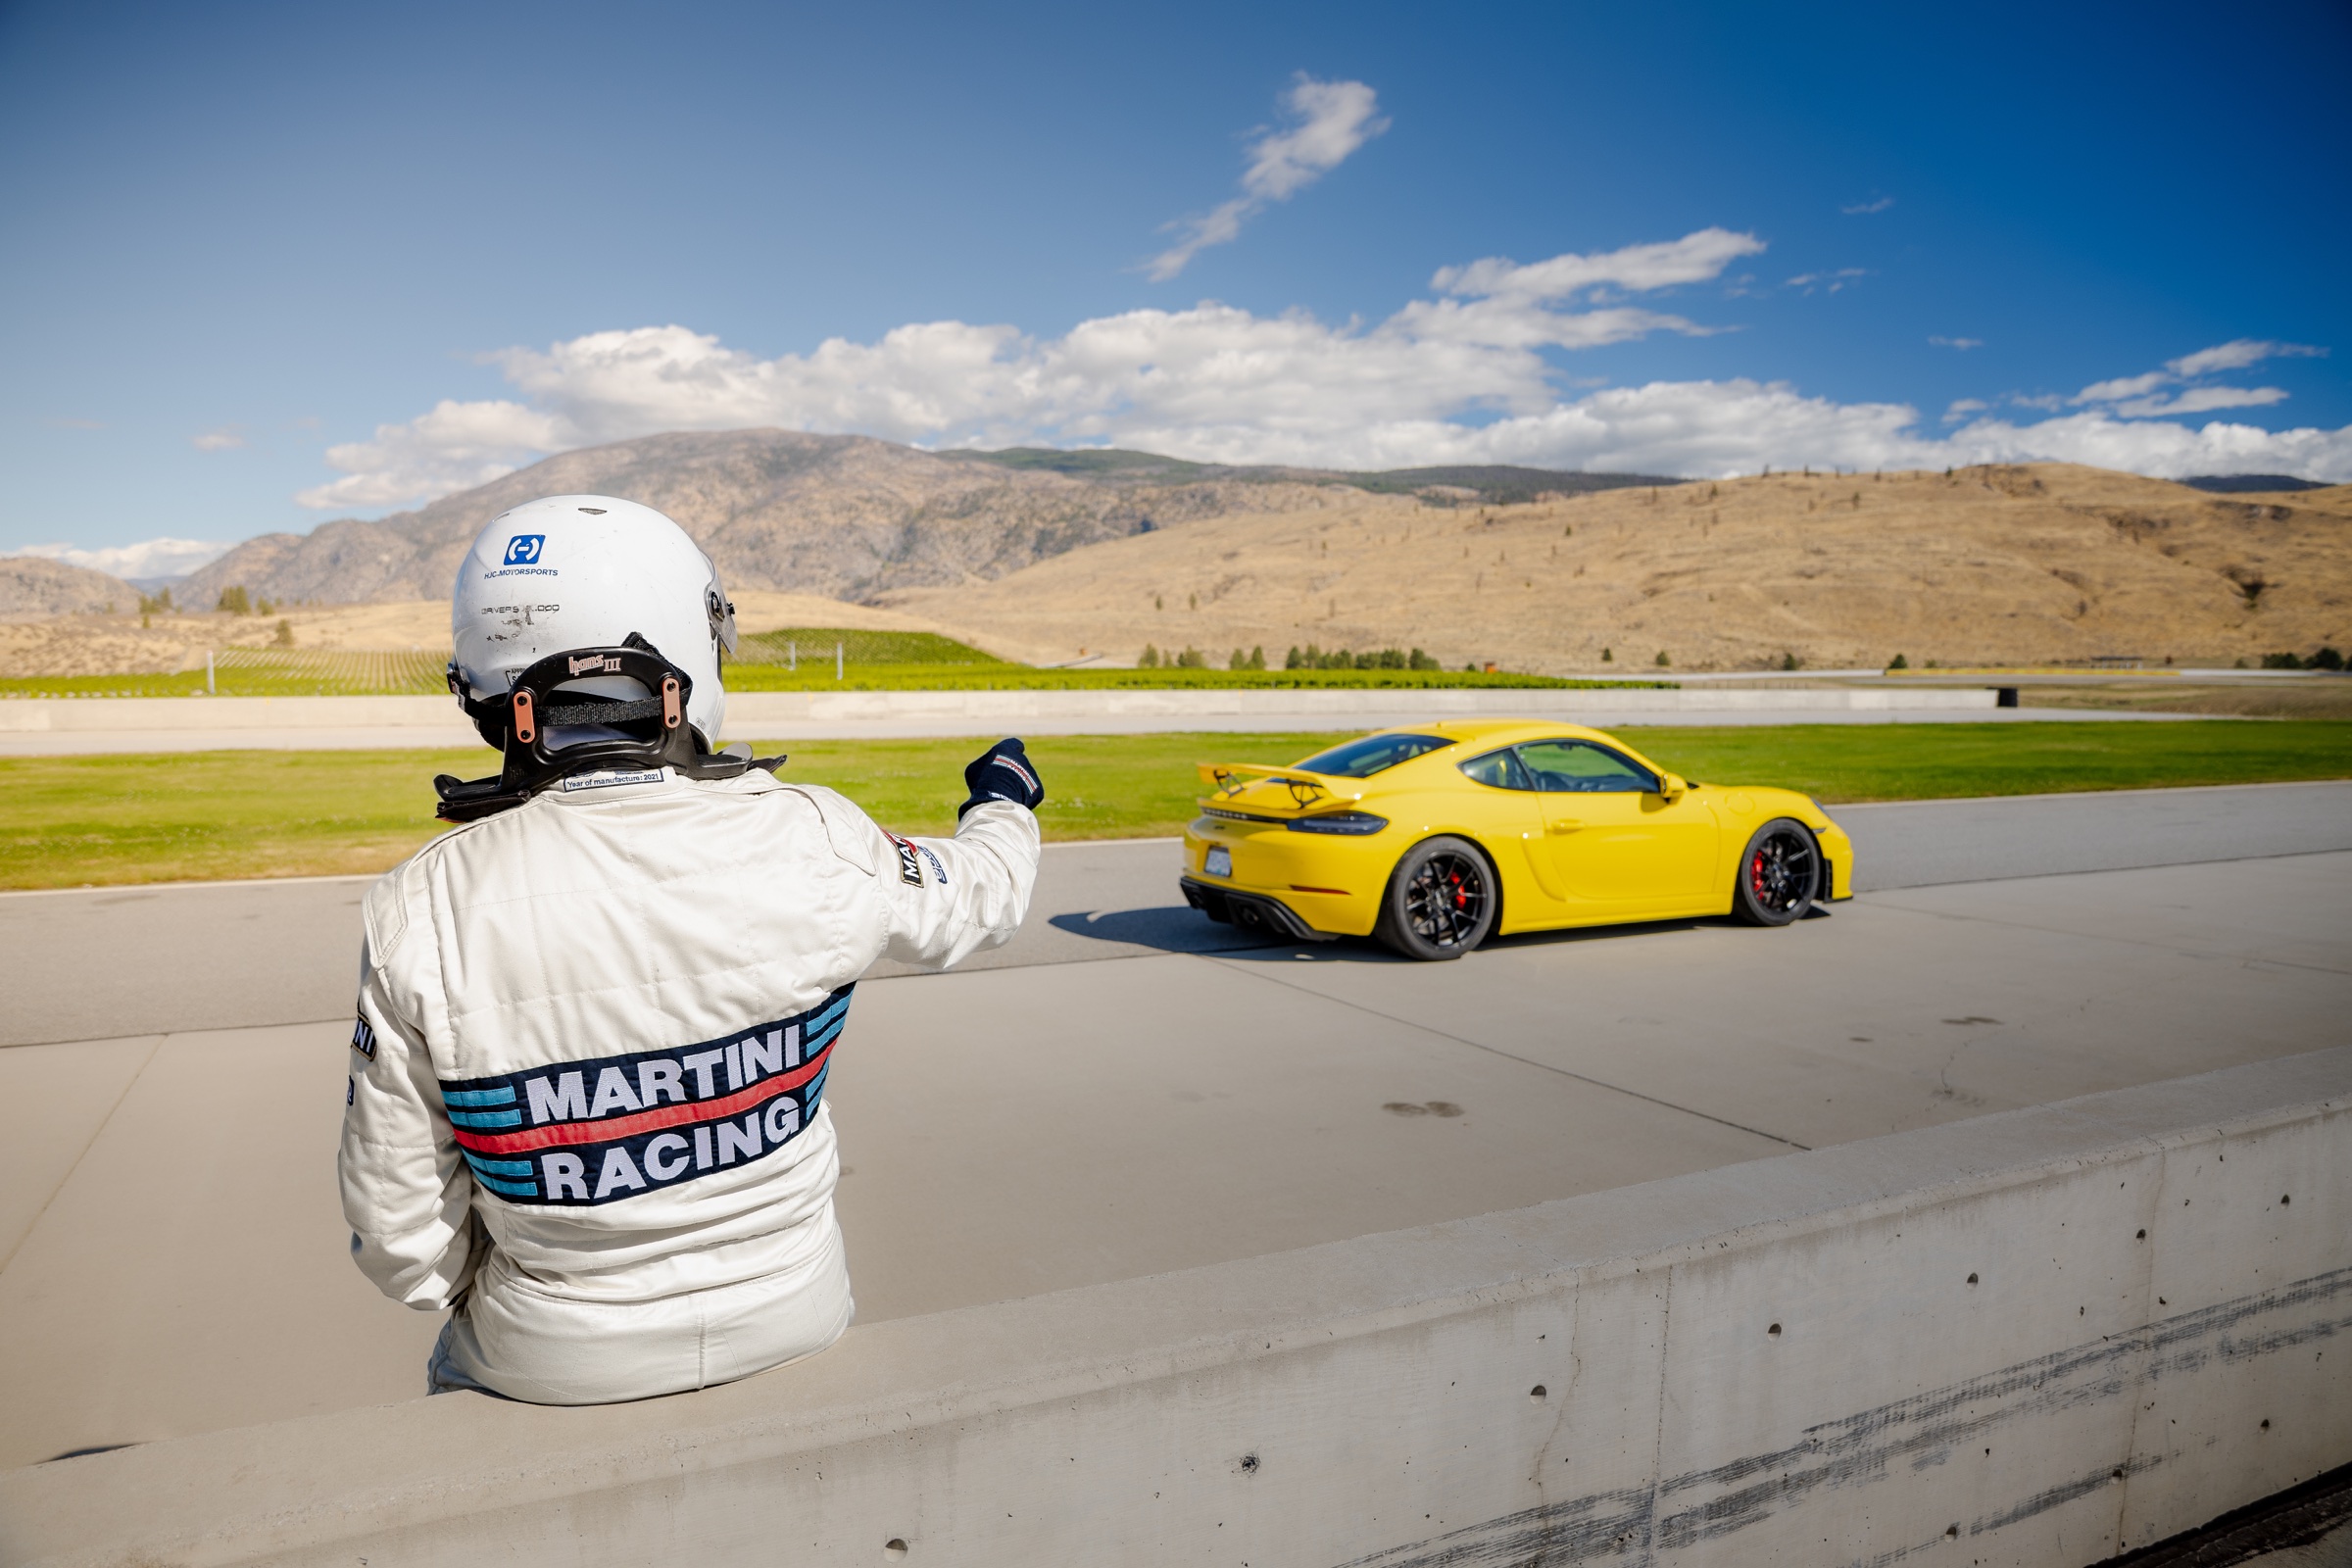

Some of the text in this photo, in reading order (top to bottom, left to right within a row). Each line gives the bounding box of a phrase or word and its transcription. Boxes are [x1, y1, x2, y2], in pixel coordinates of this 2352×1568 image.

[594, 774, 642, 785] manufacture:
[355, 1020, 374, 1053] NI
[525, 1024, 800, 1125] MARTINI
[540, 1096, 800, 1200] RACING
